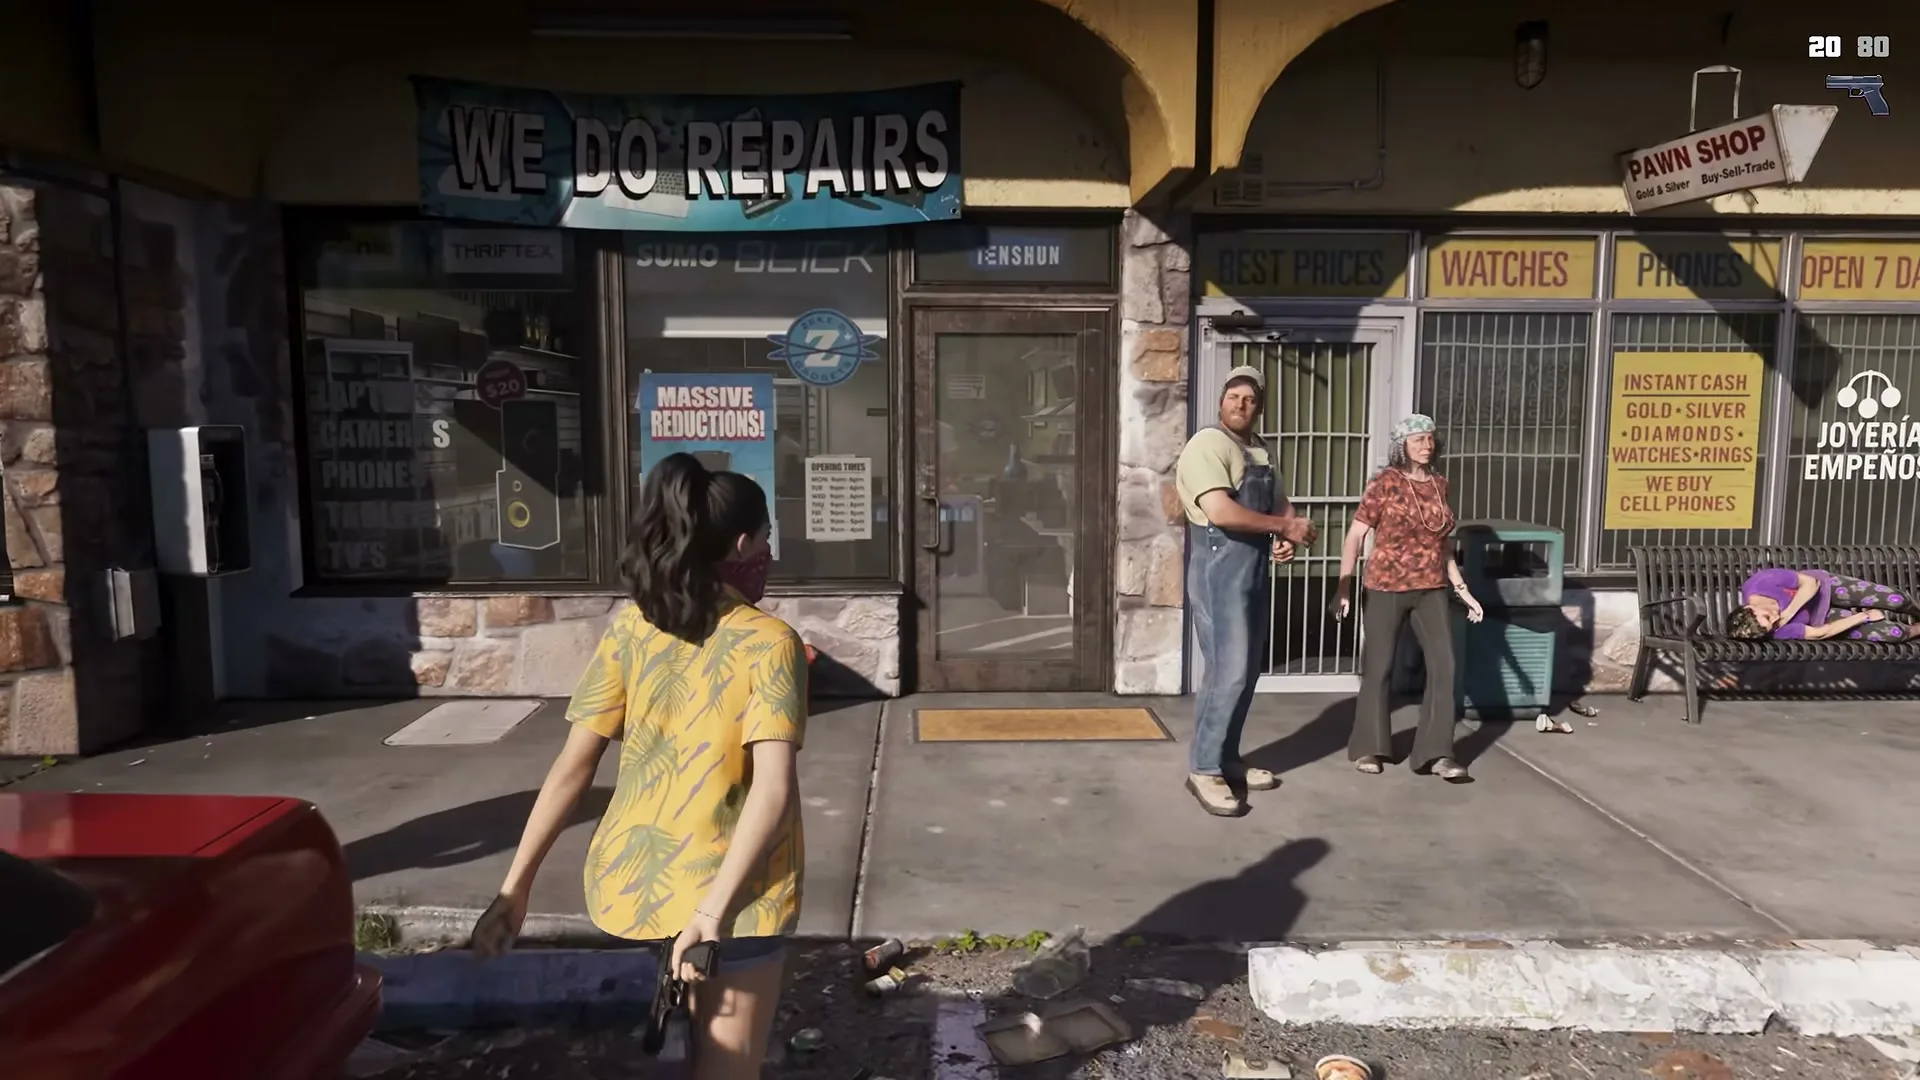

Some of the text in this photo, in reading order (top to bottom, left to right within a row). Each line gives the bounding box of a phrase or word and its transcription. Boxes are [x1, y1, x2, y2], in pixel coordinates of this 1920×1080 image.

[449, 103, 951, 200] WE DO REPAIRS
[1628, 125, 1765, 182] PAWN SHOP
[1701, 159, 1775, 185] Buy-Sell-Trade
[1636, 180, 1690, 200] Gold & Silver
[637, 243, 719, 267] SUMO
[1219, 248, 1385, 286] BEST PRICES
[1441, 249, 1569, 288] WATCHES
[1636, 251, 1743, 288] PHONES
[1800, 255, 1865, 289] OPEN
[1874, 256, 1888, 289] 7
[485, 379, 520, 398] $20
[1624, 374, 1747, 391] INSTANT CASH
[656, 386, 753, 408] MASSIVE
[1626, 402, 1746, 419] GOLD SILVER
[650, 409, 766, 438] REDUCTIONS!
[1630, 426, 1734, 442] DIAMONDS
[1817, 415, 1920, 448] JOYERÍA
[811, 463, 866, 471] OPENING TIMES
[1612, 447, 1753, 463] WATCHES RINGS
[321, 460, 427, 489] PHONES
[1646, 476, 1713, 492] WE BUY
[1620, 495, 1736, 512] CELL PHONES
